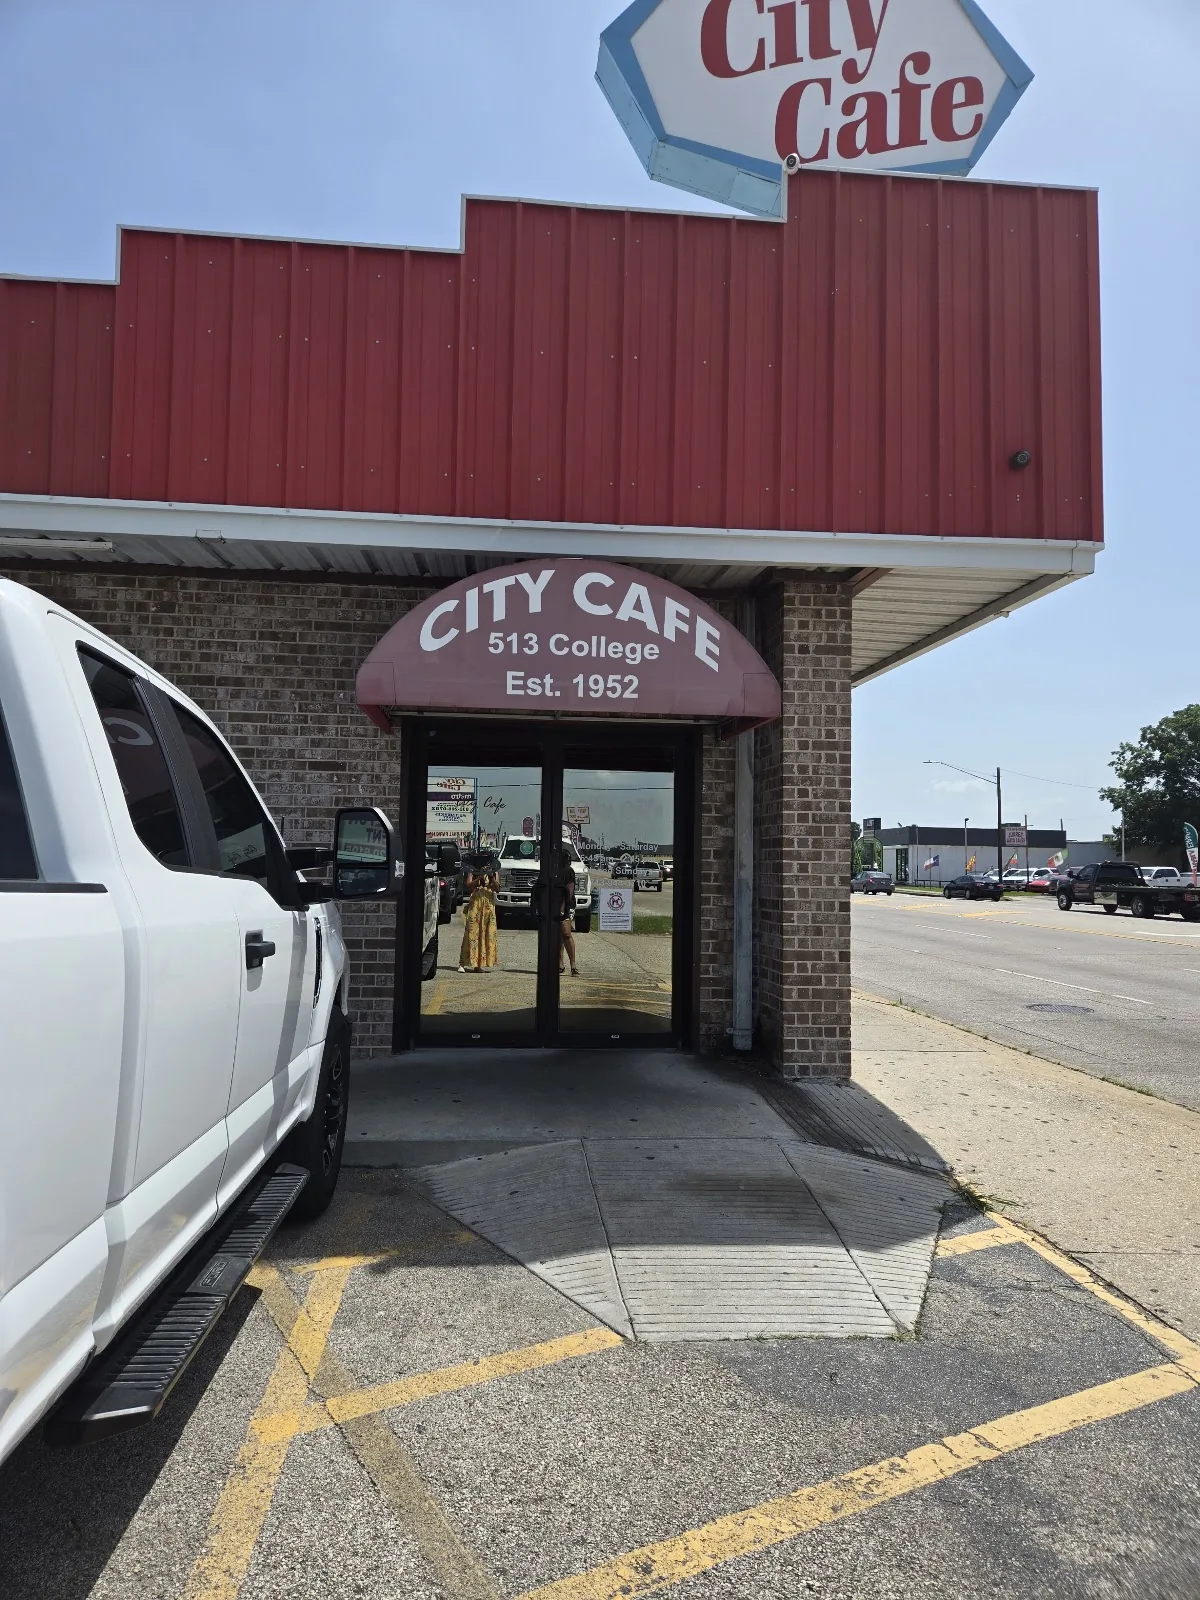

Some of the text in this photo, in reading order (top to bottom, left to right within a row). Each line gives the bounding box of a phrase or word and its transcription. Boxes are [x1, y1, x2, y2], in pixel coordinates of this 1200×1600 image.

[700, 0, 890, 85] City
[774, 50, 985, 165] Cafe
[419, 569, 721, 673] CITY CAFE
[487, 631, 661, 665] 513 College
[505, 670, 640, 700] Est. 1952
[483, 796, 507, 815] Cafe
[578, 842, 611, 852] Monday
[620, 841, 659, 853] Saturday
